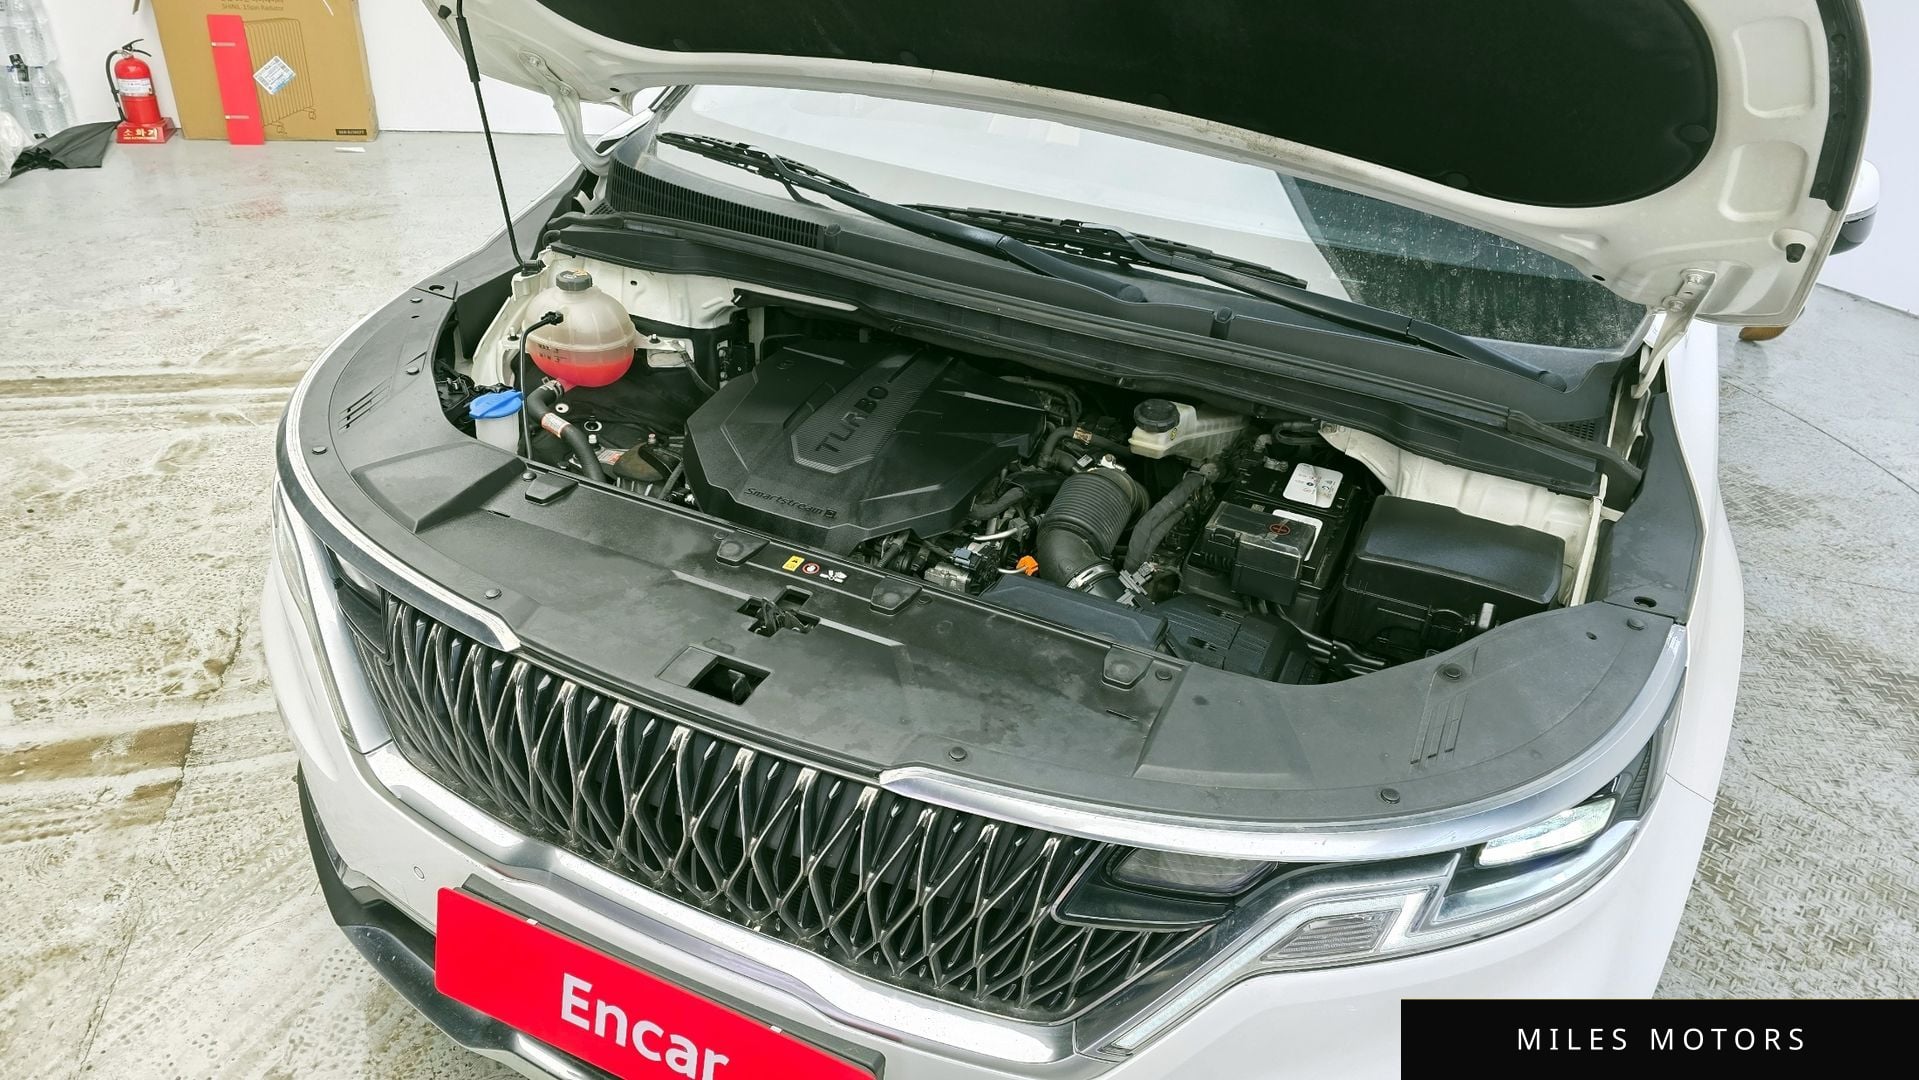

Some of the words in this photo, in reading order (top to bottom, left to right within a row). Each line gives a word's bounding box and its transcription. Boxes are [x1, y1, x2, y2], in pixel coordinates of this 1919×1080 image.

[123, 127, 158, 137] 소화기
[815, 385, 889, 453] TURBO
[743, 487, 823, 515] Smartstream
[561, 972, 730, 1080] Encar
